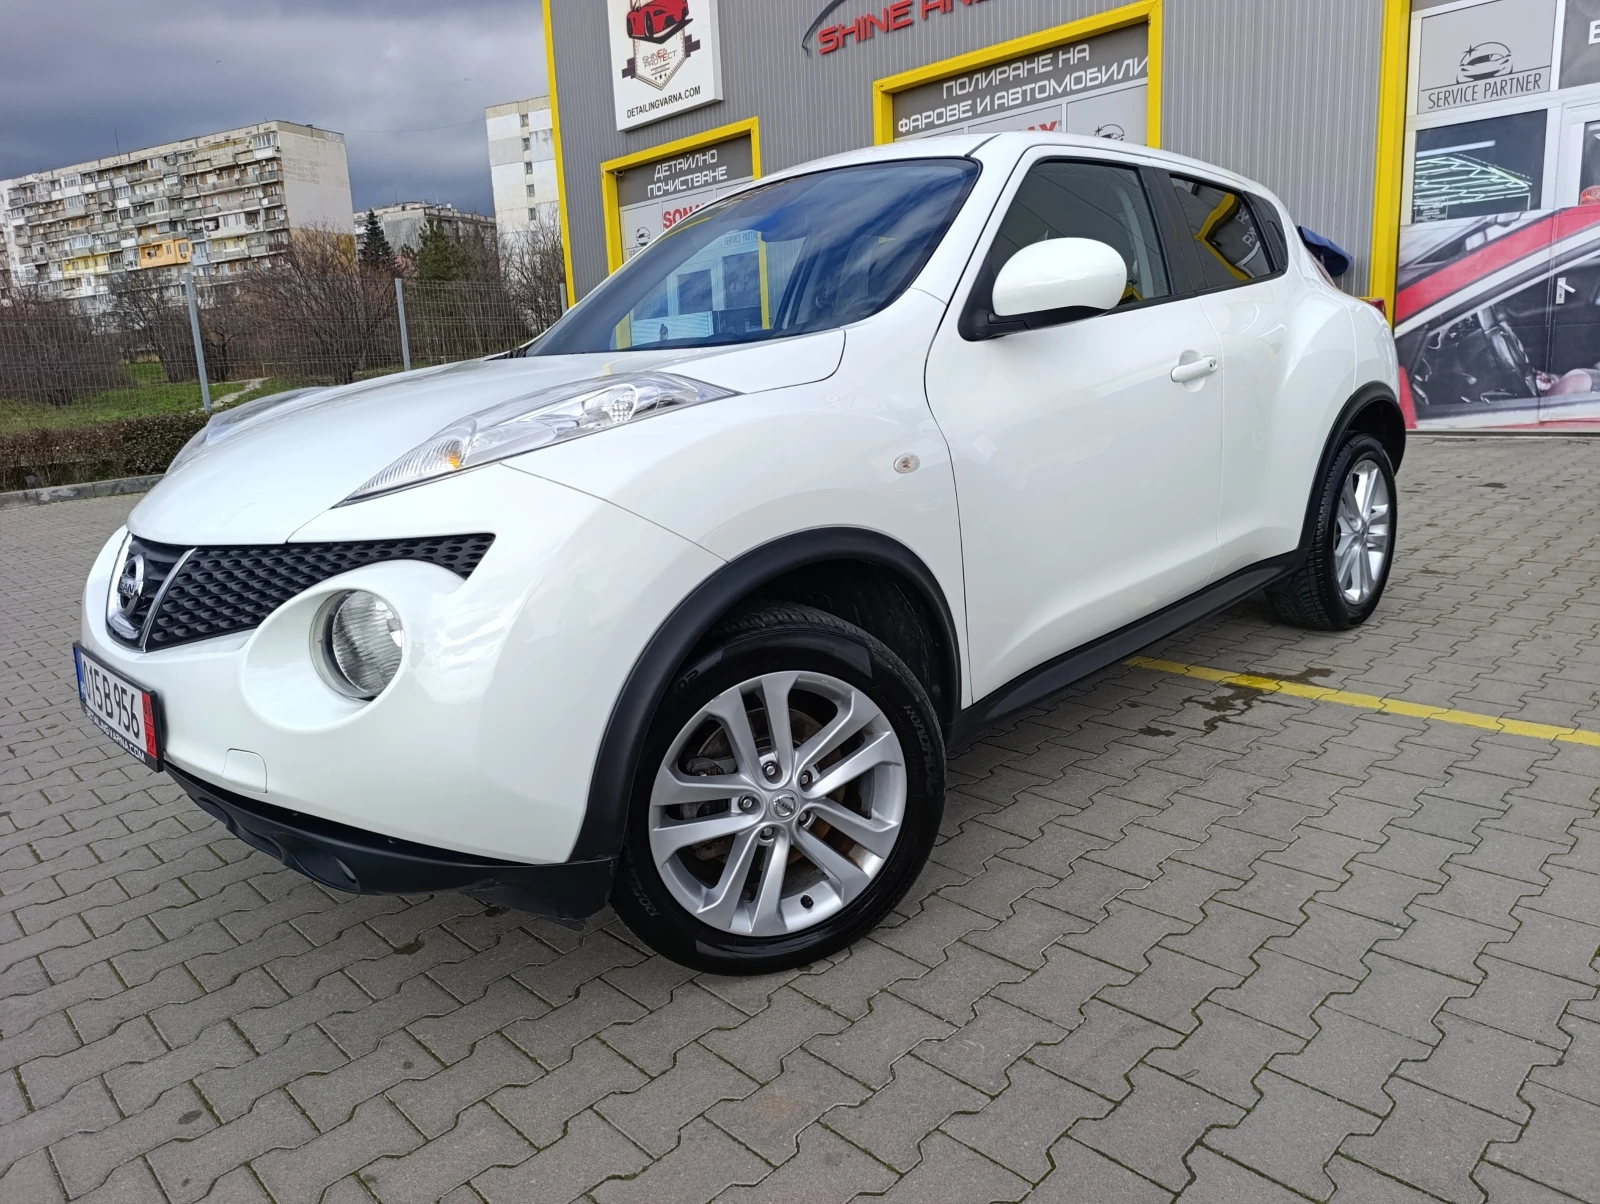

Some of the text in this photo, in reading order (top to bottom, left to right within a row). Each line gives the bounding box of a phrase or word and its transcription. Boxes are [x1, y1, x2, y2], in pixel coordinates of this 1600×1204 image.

[818, 0, 912, 54] SHINE
[642, 50, 677, 69] PROTECT
[943, 44, 1090, 100] ПОЛИРАНЕ НА
[627, 85, 701, 118] DETAILINGVARNA.COM
[898, 55, 1149, 133] ФАРОВЕ И АВТОМОБИЛИ
[1428, 72, 1542, 110] SERVICE PARTNER
[647, 166, 728, 198] ПОЧИСТВАНЕ
[654, 150, 718, 181] ДЕТАЙЛНО
